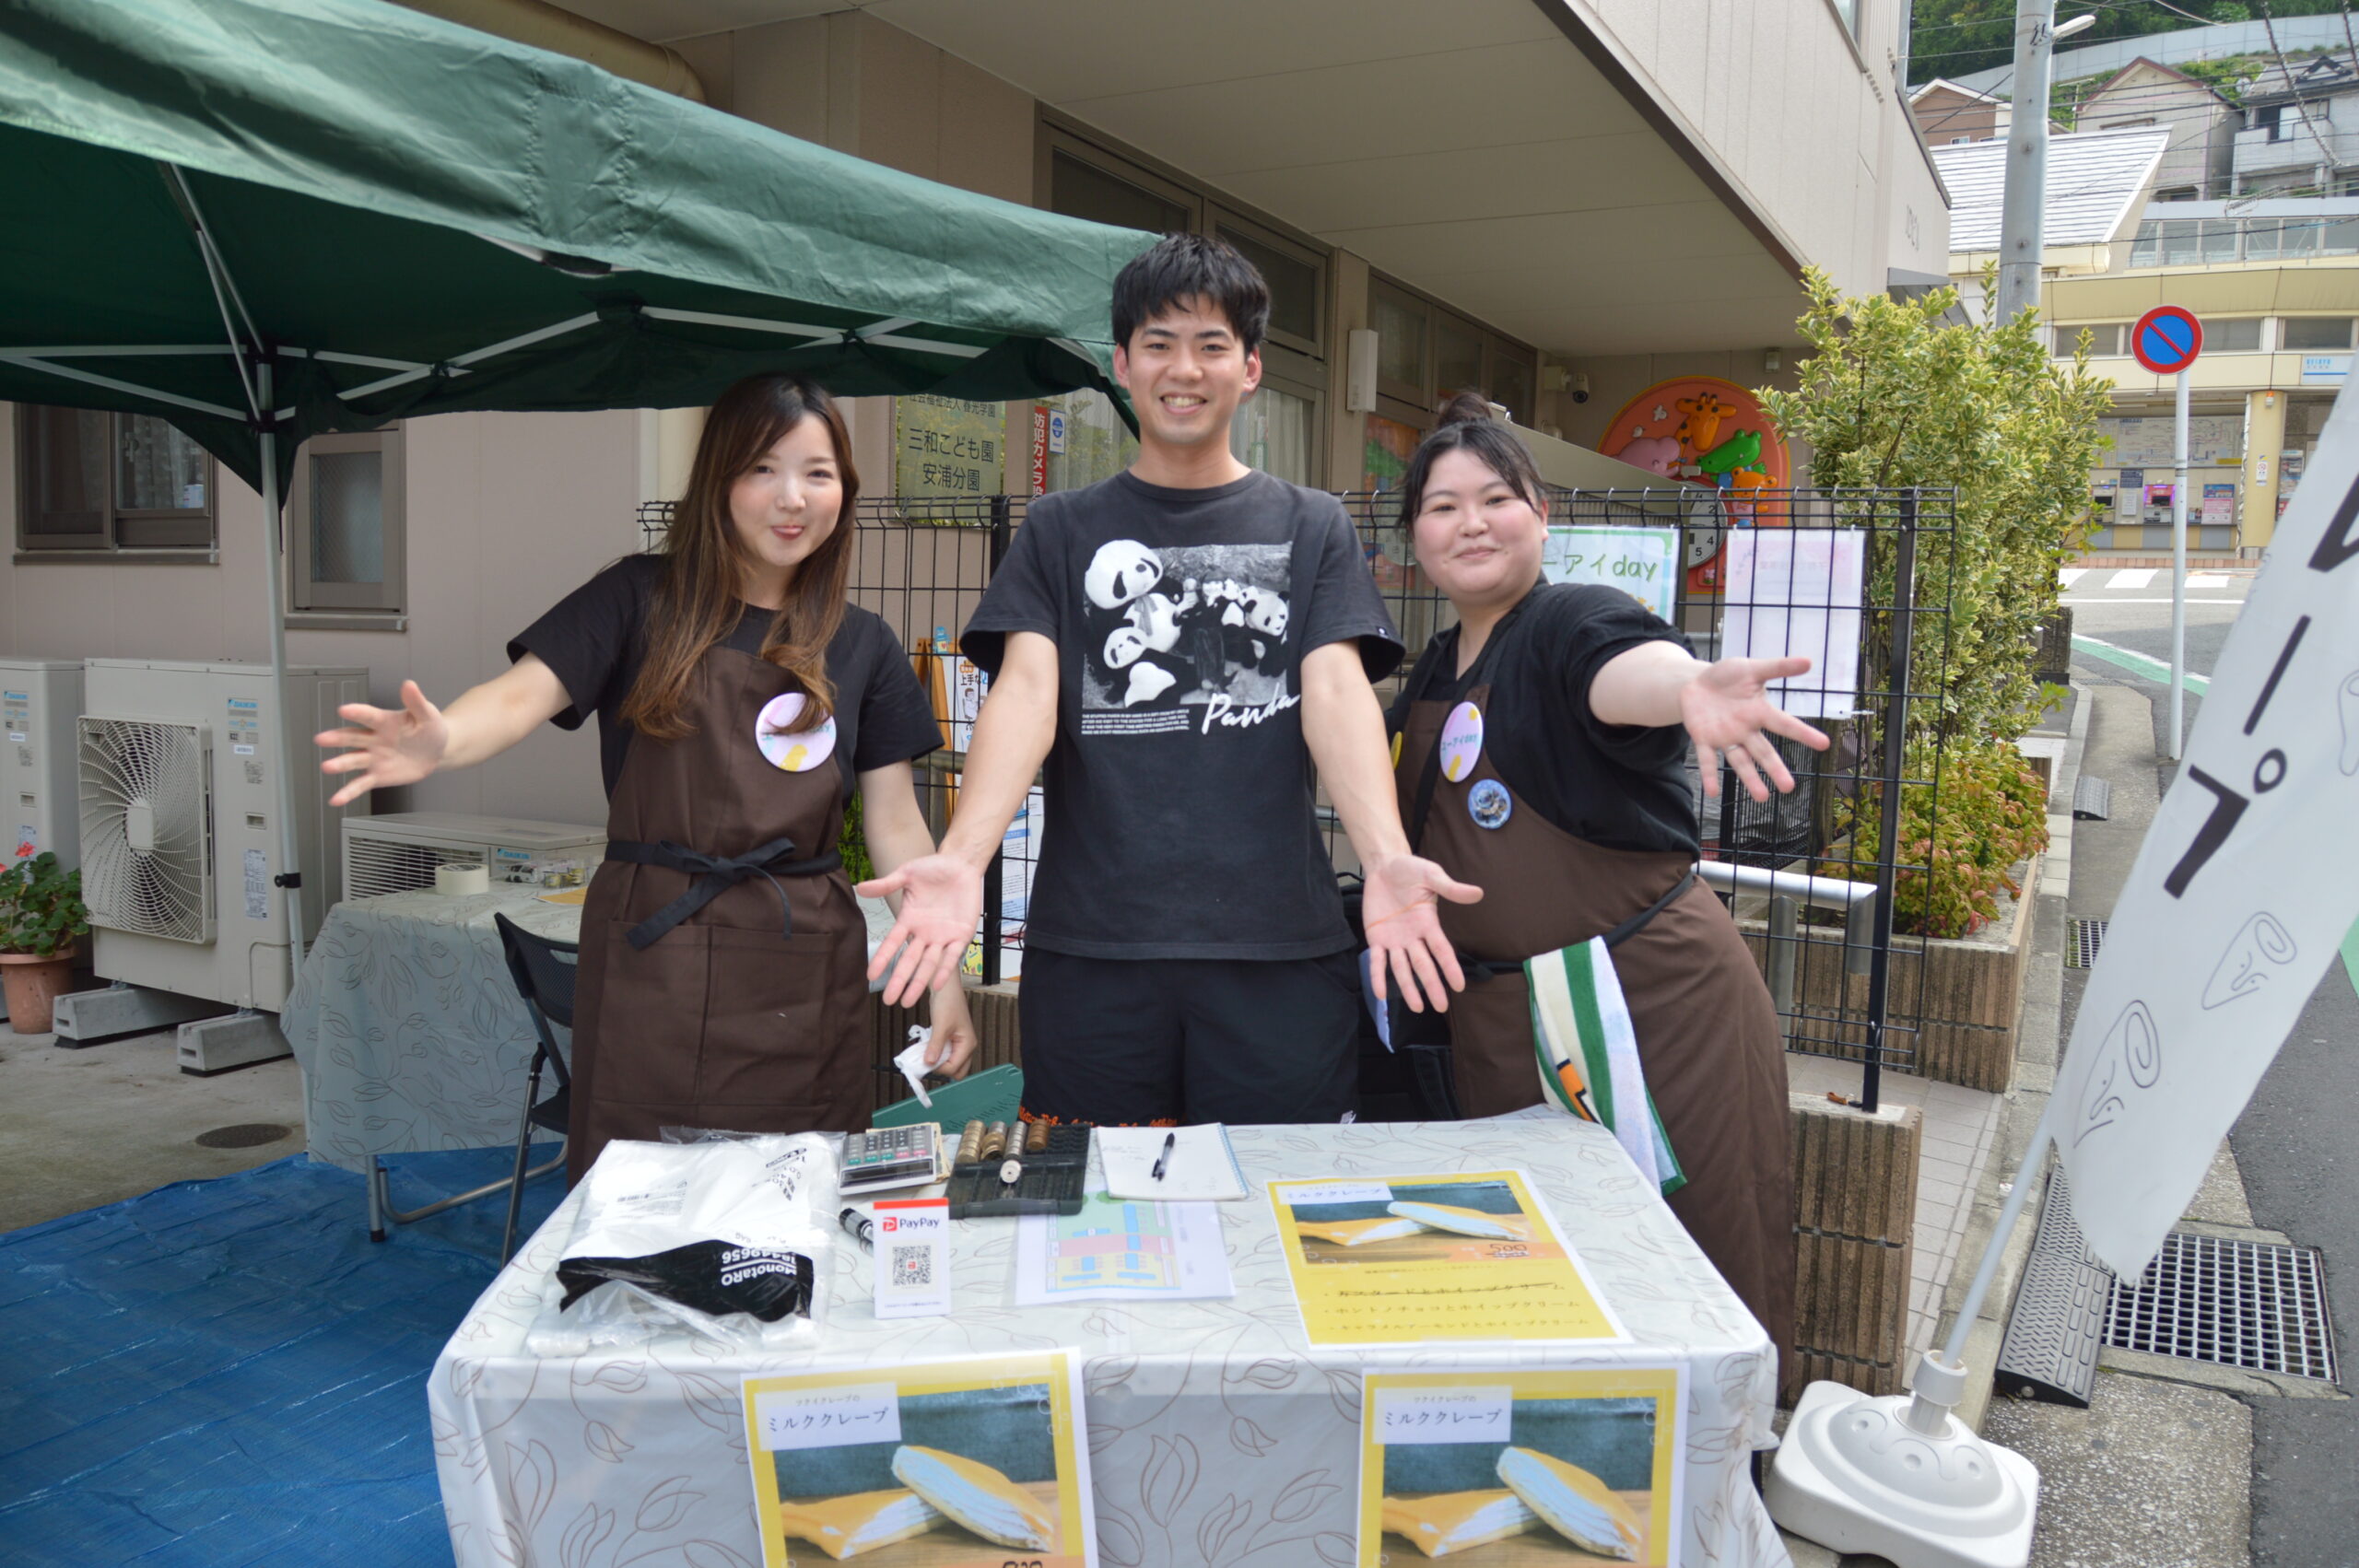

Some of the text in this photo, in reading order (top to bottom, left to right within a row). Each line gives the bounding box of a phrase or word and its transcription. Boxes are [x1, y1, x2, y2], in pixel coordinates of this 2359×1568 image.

[909, 427, 993, 463] 三和こども園
[922, 462, 980, 492] 安浦分園
[1707, 536, 1714, 545] 4
[1696, 547, 1703, 556] 5
[1201, 682, 1301, 735] Panda
[899, 1217, 939, 1230] PayPay
[721, 1263, 797, 1287] MonotaRO
[1385, 1408, 1503, 1426] ミルククレープ
